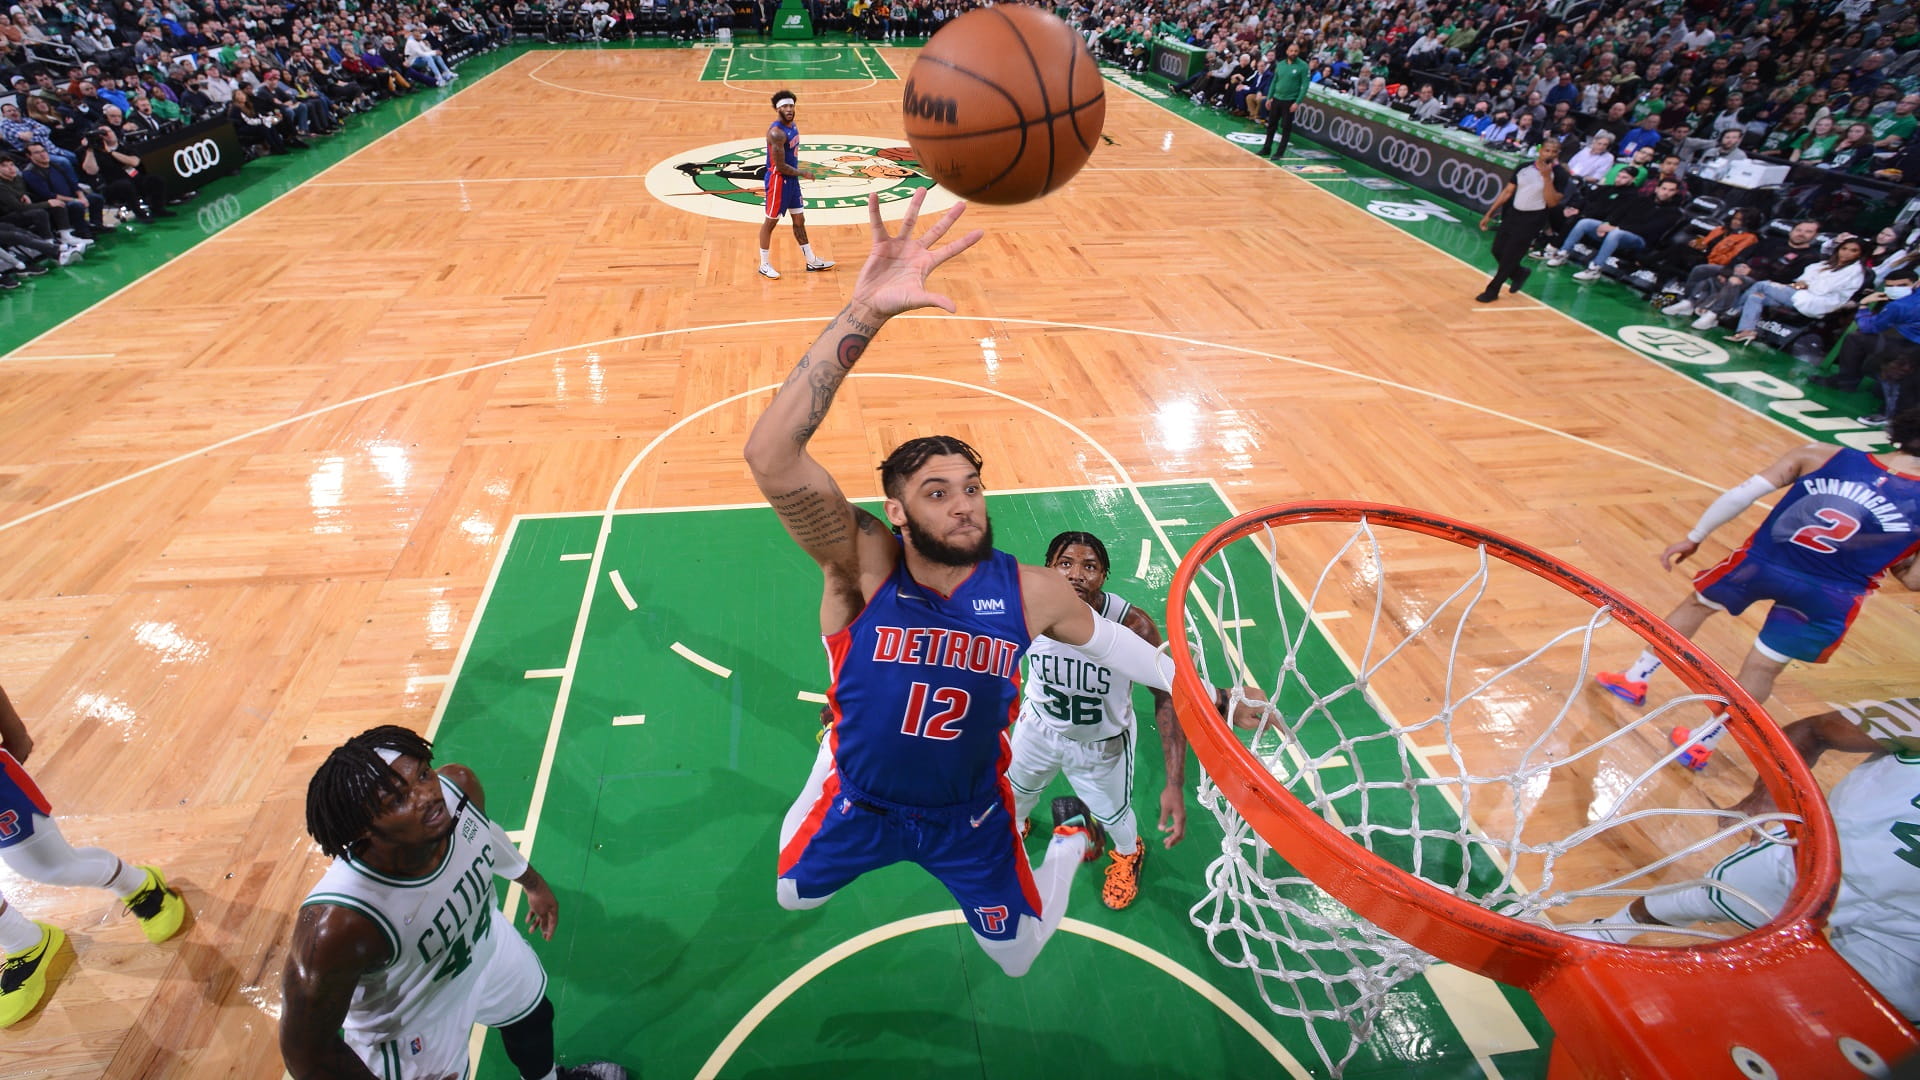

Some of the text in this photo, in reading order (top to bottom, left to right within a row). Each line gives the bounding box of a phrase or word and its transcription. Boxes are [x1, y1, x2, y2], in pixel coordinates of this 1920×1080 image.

[736, 144, 873, 158] BTON
[1803, 478, 1912, 532] CUNNINGHAM
[1789, 507, 1861, 553] 2
[972, 599, 1005, 610] UWM
[872, 626, 1019, 678] DETROIT
[1030, 653, 1112, 695] CELTICS
[900, 682, 970, 741] 12
[1043, 685, 1102, 726] 36
[431, 891, 492, 983] 44
